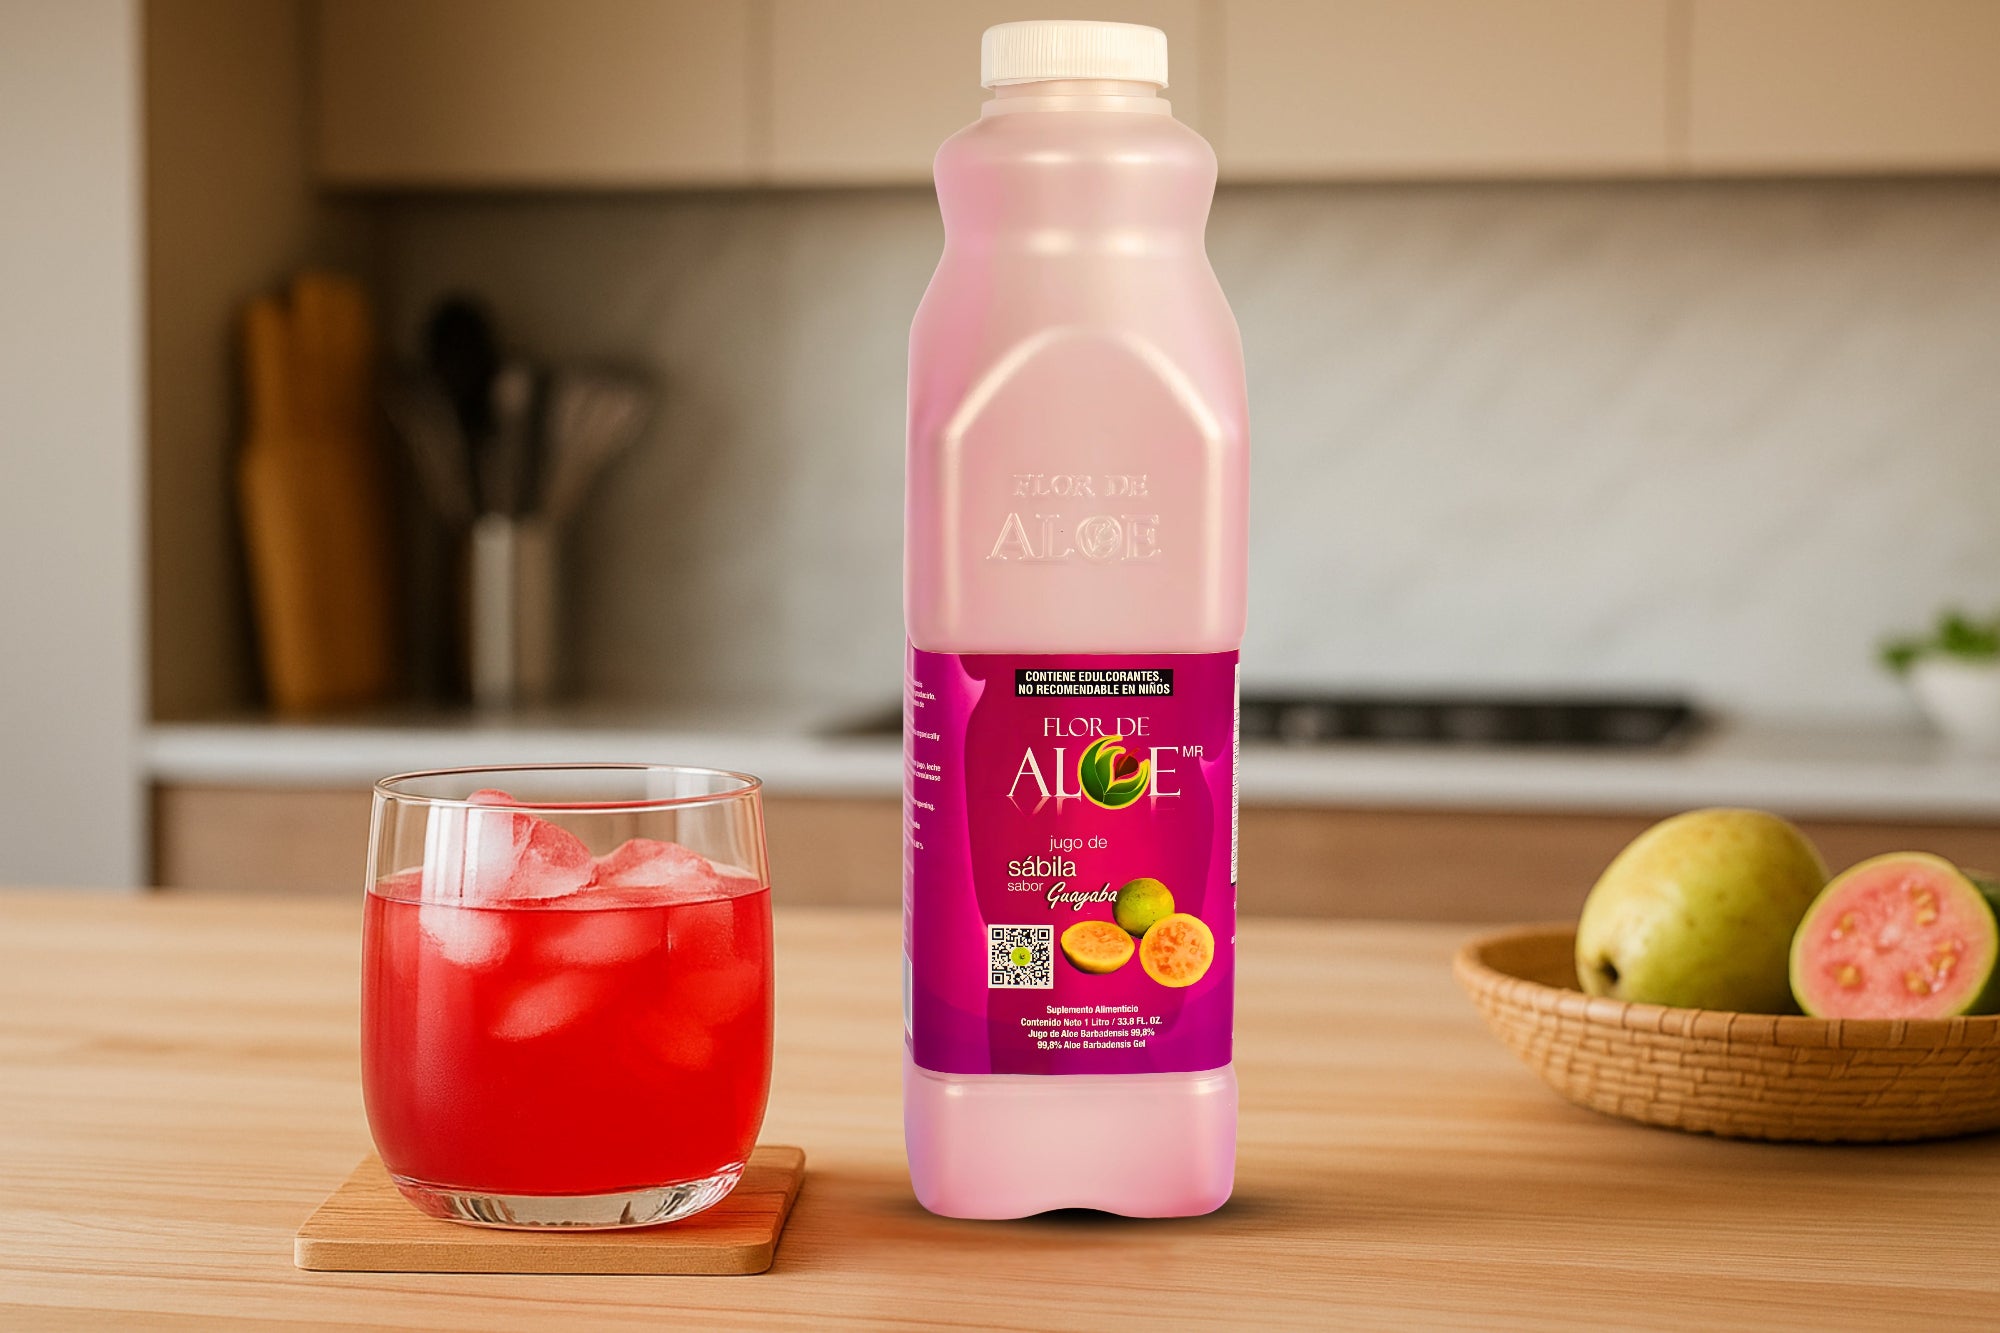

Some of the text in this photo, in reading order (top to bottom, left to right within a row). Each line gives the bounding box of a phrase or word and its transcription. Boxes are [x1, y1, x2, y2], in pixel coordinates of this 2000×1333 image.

[1012, 474, 1149, 496] FLOR DE
[985, 512, 1162, 560] ALOE
[1025, 671, 1163, 683] CONTIENE EDULCORANTES,
[1018, 682, 1170, 695] NO RECOMENDABLE EN NIÑOS
[1043, 717, 1150, 737] FLOR DE
[1183, 745, 1204, 758] MR
[1049, 835, 1108, 852] jugo de
[1008, 855, 1077, 877] sábila
[1007, 880, 1118, 911] sabor Guayaba
[1046, 1005, 1139, 1015] Suplemento Alimenticio
[1020, 1018, 1061, 1027] Contenido
[1063, 1018, 1082, 1026] Neto
[1084, 1018, 1089, 1026] 1
[1091, 1018, 1110, 1026] Litro
[1117, 1017, 1135, 1026] 33.8
[1136, 1017, 1148, 1025] FL.
[1149, 1016, 1163, 1025] OZ.
[1028, 1028, 1155, 1039] Jugo de Aloe Barbadensis 99,8%
[1037, 1040, 1146, 1050] 99,8% Aloe Barbadensis Gel
